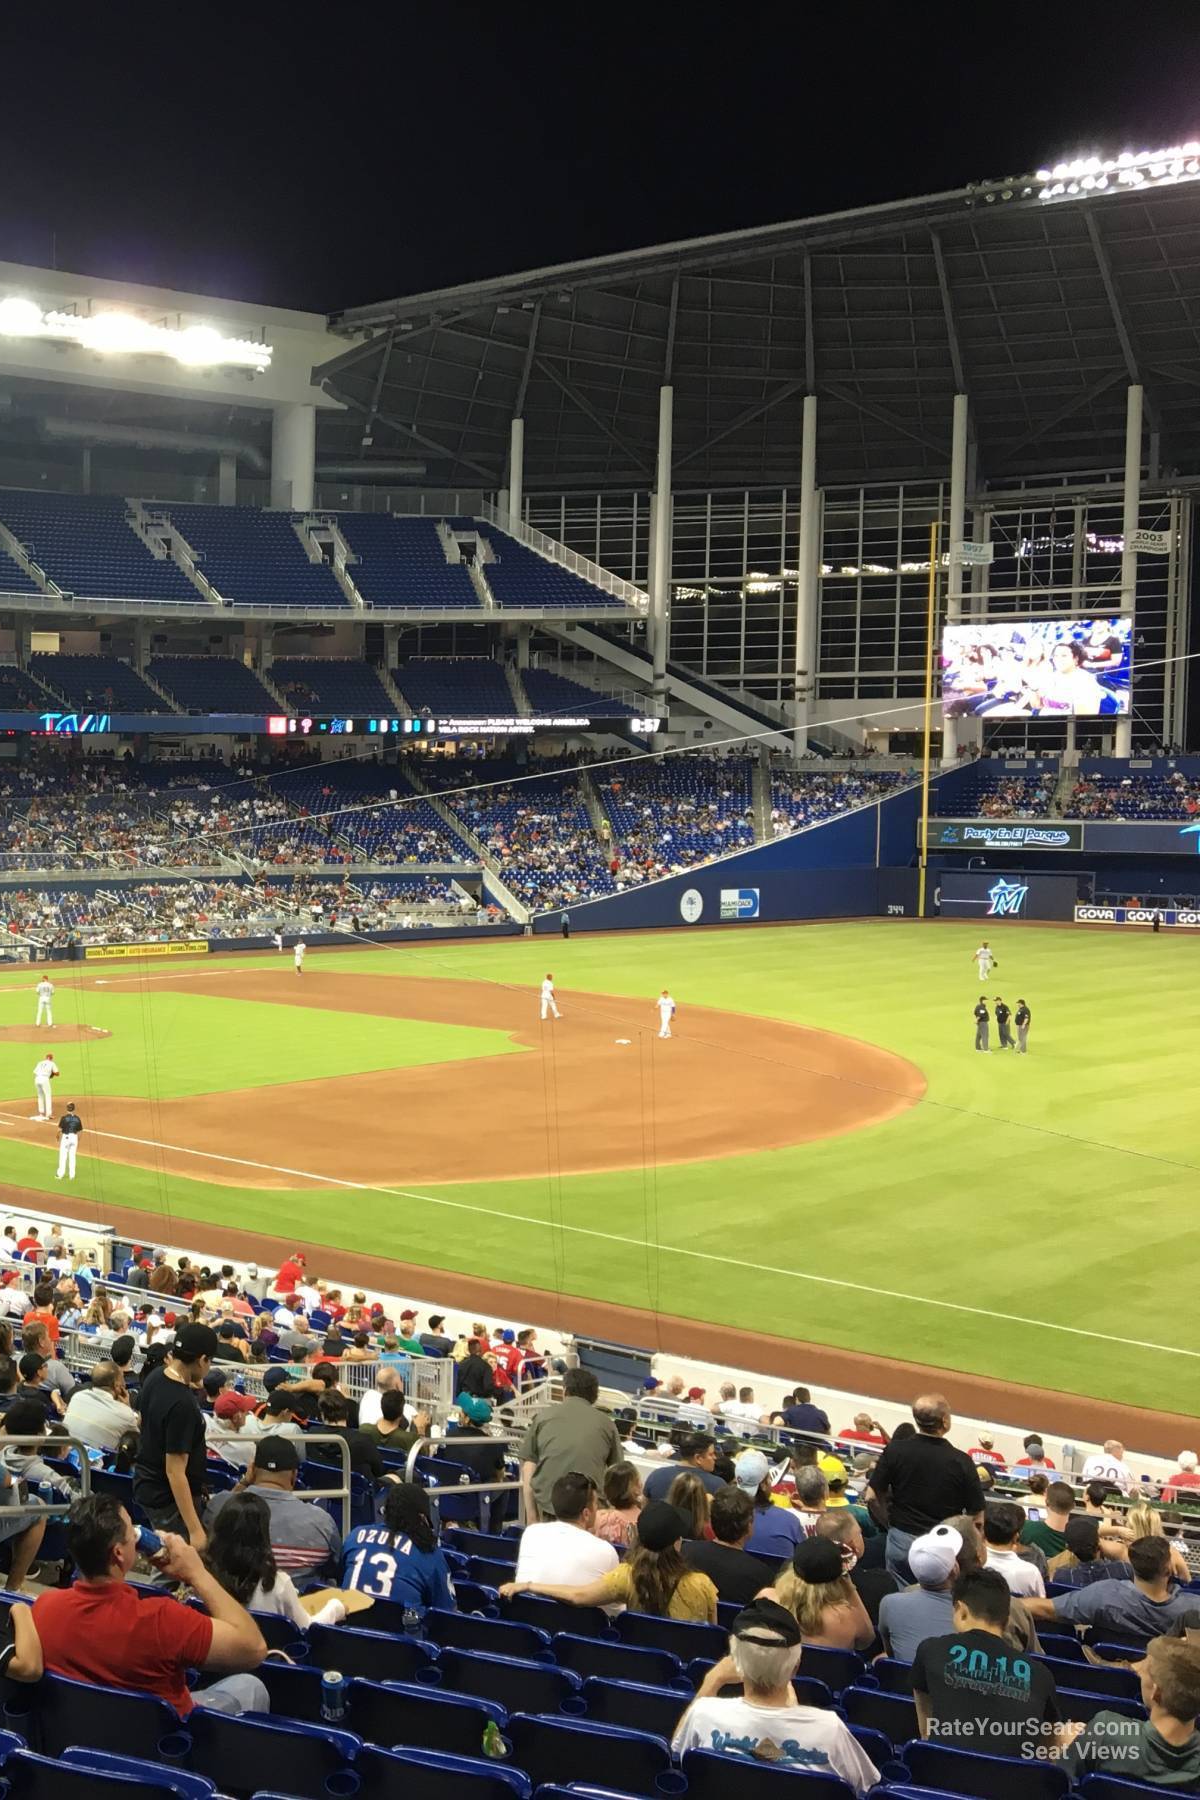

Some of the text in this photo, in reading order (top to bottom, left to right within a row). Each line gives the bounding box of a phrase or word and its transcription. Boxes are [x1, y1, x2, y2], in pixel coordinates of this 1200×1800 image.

[1135, 531, 1164, 542] 2003
[964, 827, 996, 840] Party
[996, 828, 1011, 839] En
[1012, 828, 1024, 839] El
[1025, 828, 1068, 842] Parque
[887, 905, 904, 915] 344
[1078, 909, 1115, 920] GOYA
[349, 1549, 398, 1598] 13
[949, 1645, 1031, 1687] 2019
